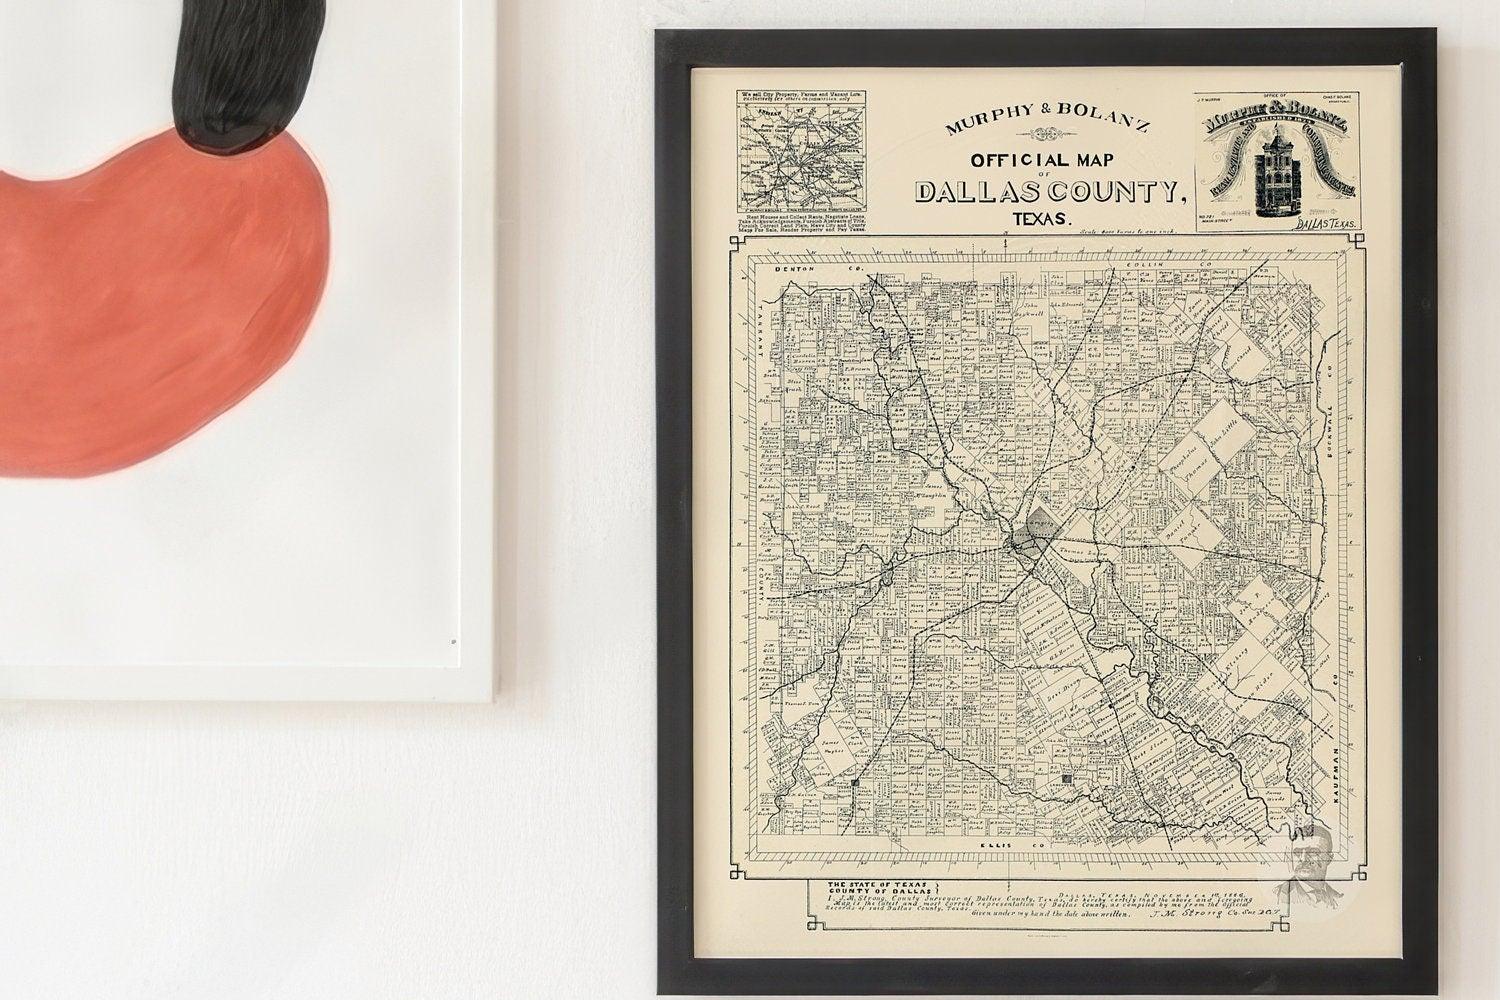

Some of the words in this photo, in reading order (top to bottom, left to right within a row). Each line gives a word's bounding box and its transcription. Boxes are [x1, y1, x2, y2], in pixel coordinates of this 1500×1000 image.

[1268, 100, 1286, 114] &
[945, 103, 1034, 137] MURPHY
[1041, 102, 1051, 113] &
[1057, 102, 1151, 134] BOLANZ
[970, 153, 1069, 167] OFFICIAL
[1078, 153, 1114, 167] MAP
[915, 181, 1040, 203] DALLAS
[1048, 181, 1187, 204] COUNTY,
[1013, 212, 1072, 226] TEXAS.
[1297, 218, 1328, 230] DALLAS
[1329, 218, 1356, 228] TEXAS.
[1328, 366, 1332, 378] CO
[1222, 419, 1237, 436] Little
[1185, 458, 1208, 481] Thomas
[1333, 674, 1338, 685] CO
